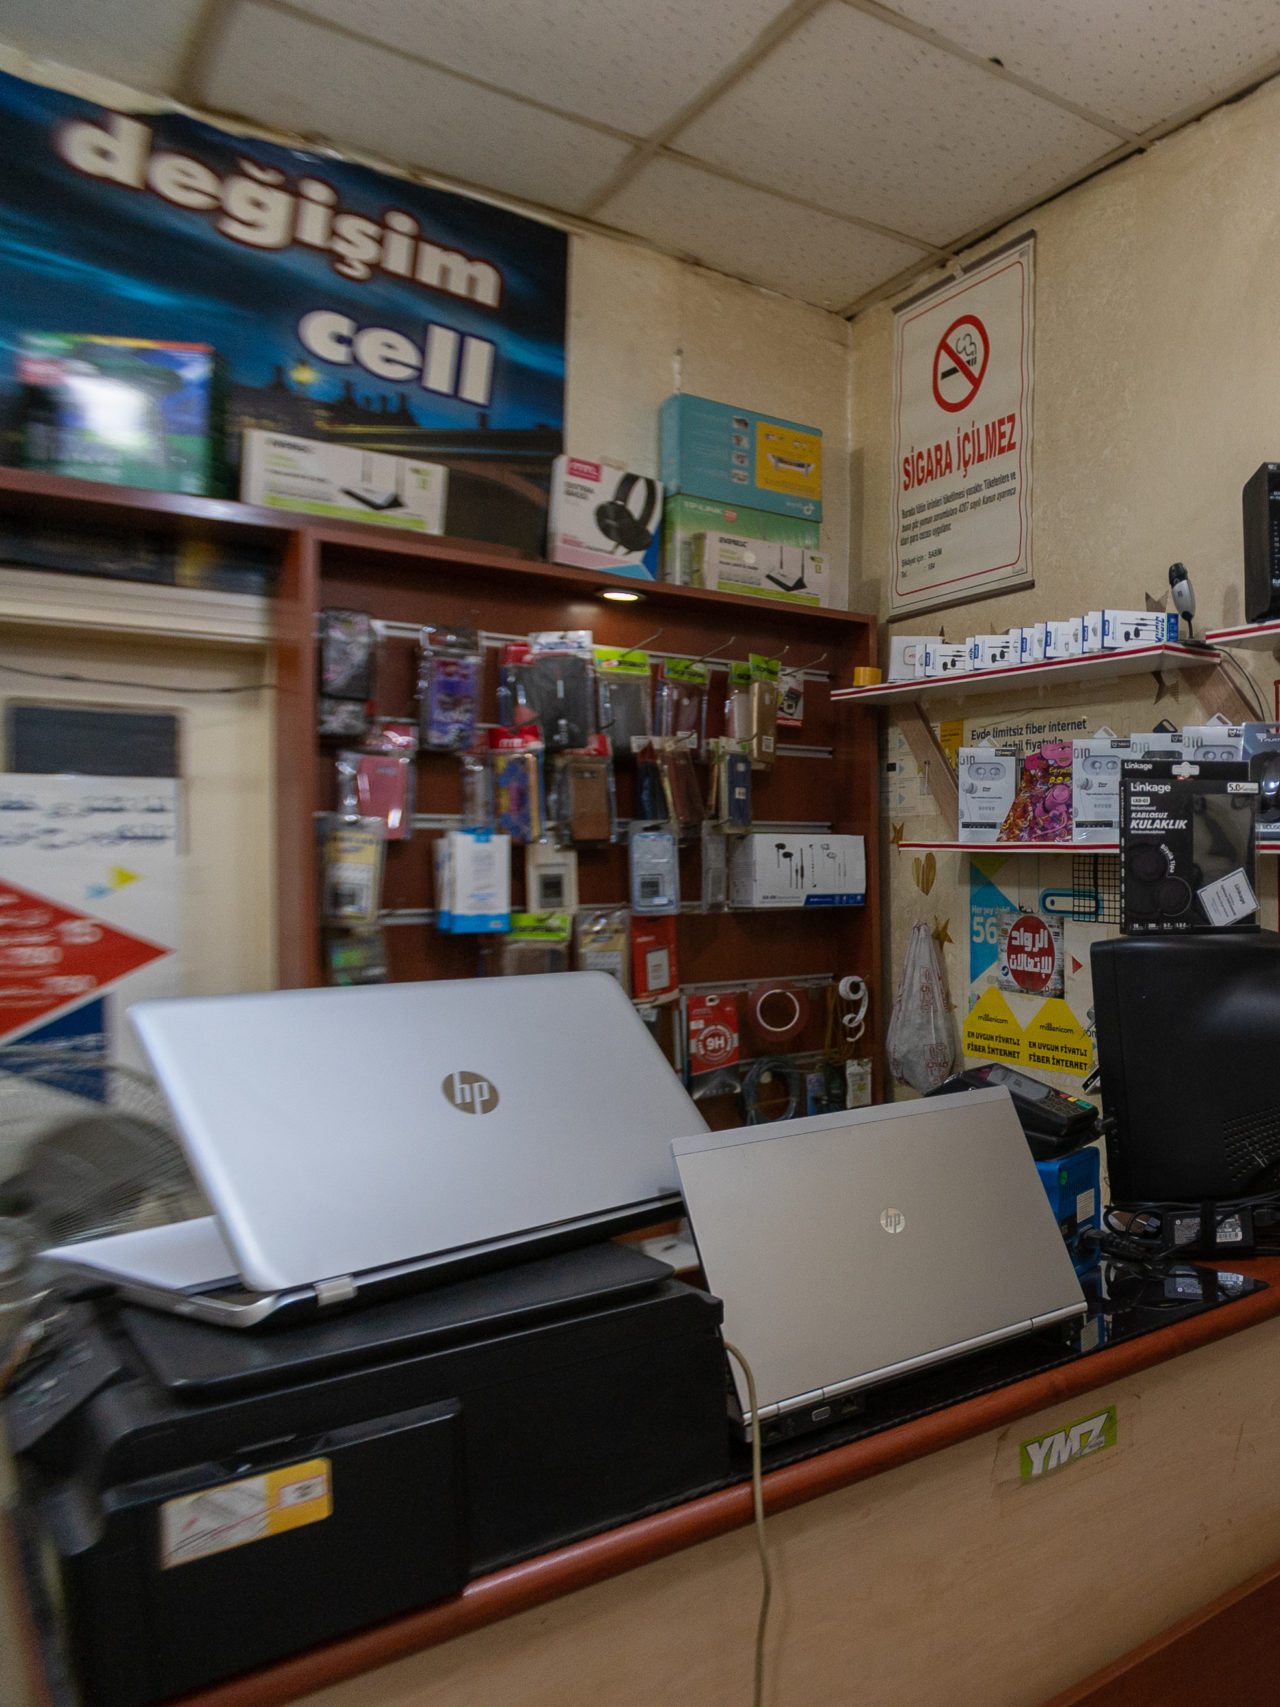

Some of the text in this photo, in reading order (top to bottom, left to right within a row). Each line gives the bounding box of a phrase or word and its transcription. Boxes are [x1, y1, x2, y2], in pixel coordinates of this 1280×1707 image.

[58, 113, 500, 308] değişim
[299, 310, 496, 406] cell
[903, 413, 1016, 491] SİGARA İÇİLMEZ
[971, 719, 1087, 740] Evde limitsiz fiber internet
[1124, 762, 1152, 770] Linkage
[1130, 782, 1171, 794] Linkage
[1130, 820, 1188, 829] KULAKLIK
[972, 916, 998, 944] 56
[1011, 927, 1048, 951] الرواد
[706, 1036, 725, 1050] 9H
[967, 1043, 1020, 1059] FİBER İNTERNET
[1029, 1052, 1087, 1071] FİBER İNTERNET
[453, 1071, 490, 1115] hp
[885, 1211, 900, 1232] hp
[1025, 1412, 1109, 1476] YMZ
